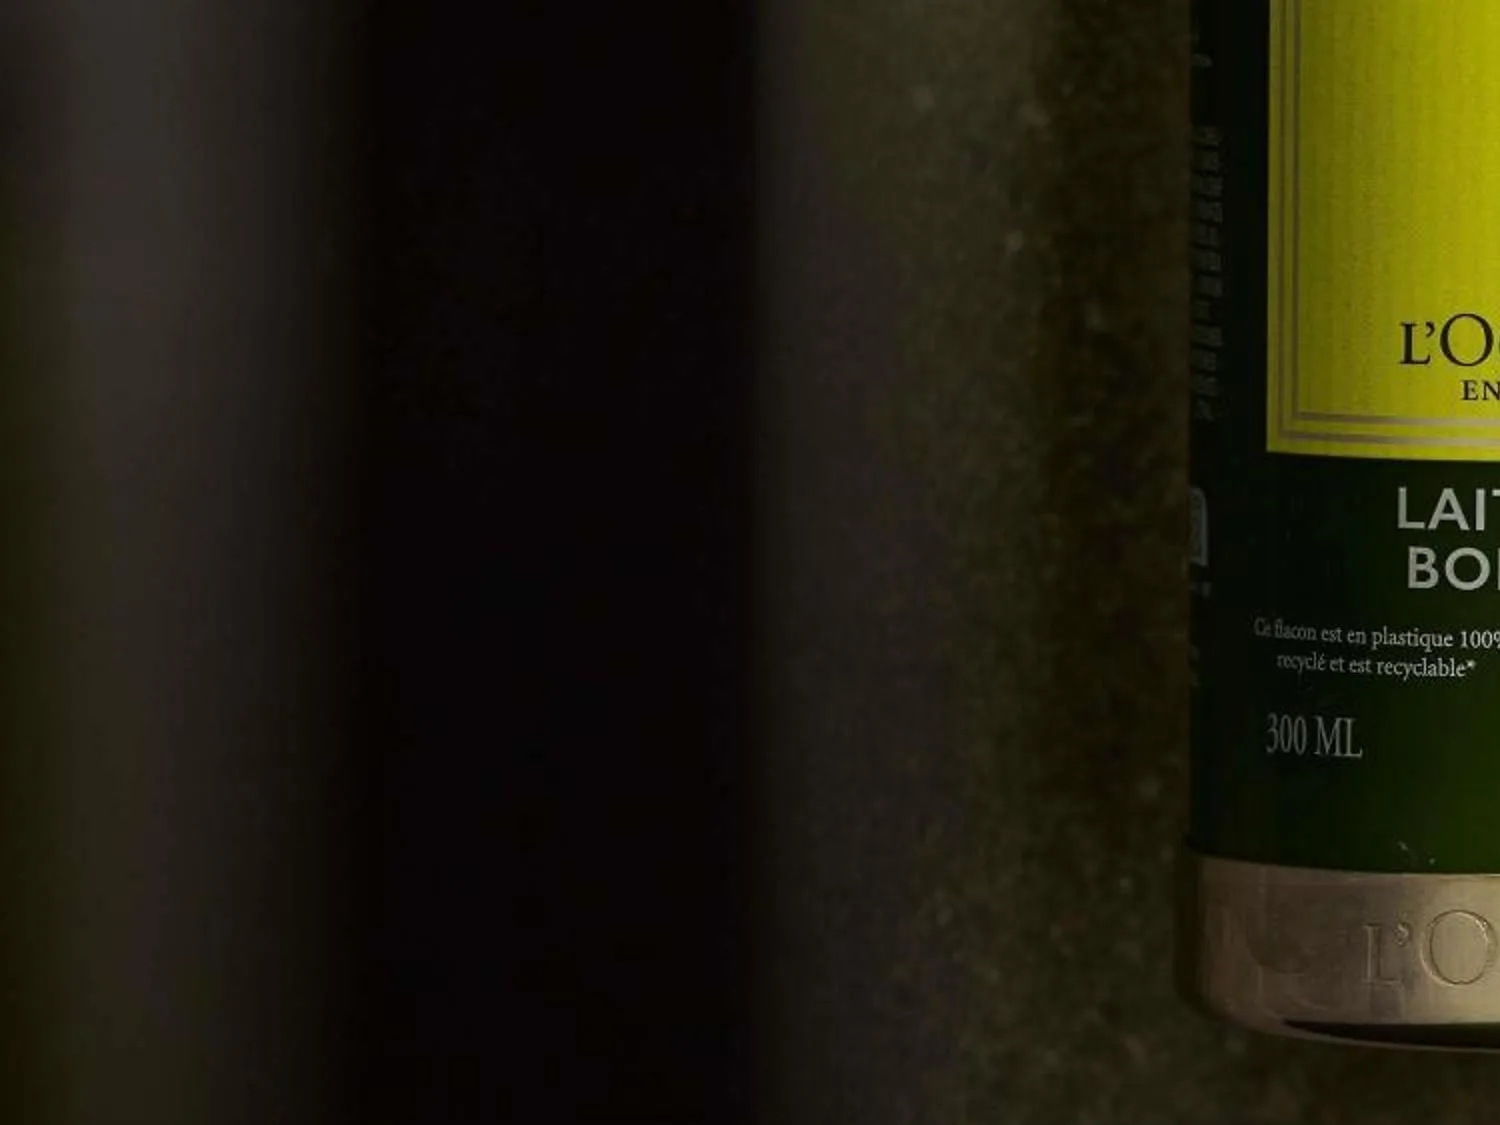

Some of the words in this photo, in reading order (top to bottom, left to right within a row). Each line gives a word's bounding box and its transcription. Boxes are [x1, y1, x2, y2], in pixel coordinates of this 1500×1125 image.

[1254, 617, 1271, 636] Ce
[1275, 619, 1317, 641] flacon
[1321, 628, 1342, 643] est
[1347, 630, 1366, 645] en
[1372, 626, 1453, 652] plastique
[1277, 653, 1324, 674] recyclé
[1330, 656, 1345, 672] et
[1350, 657, 1371, 673] est
[1266, 713, 1307, 754] 300
[1314, 716, 1363, 758] ML
